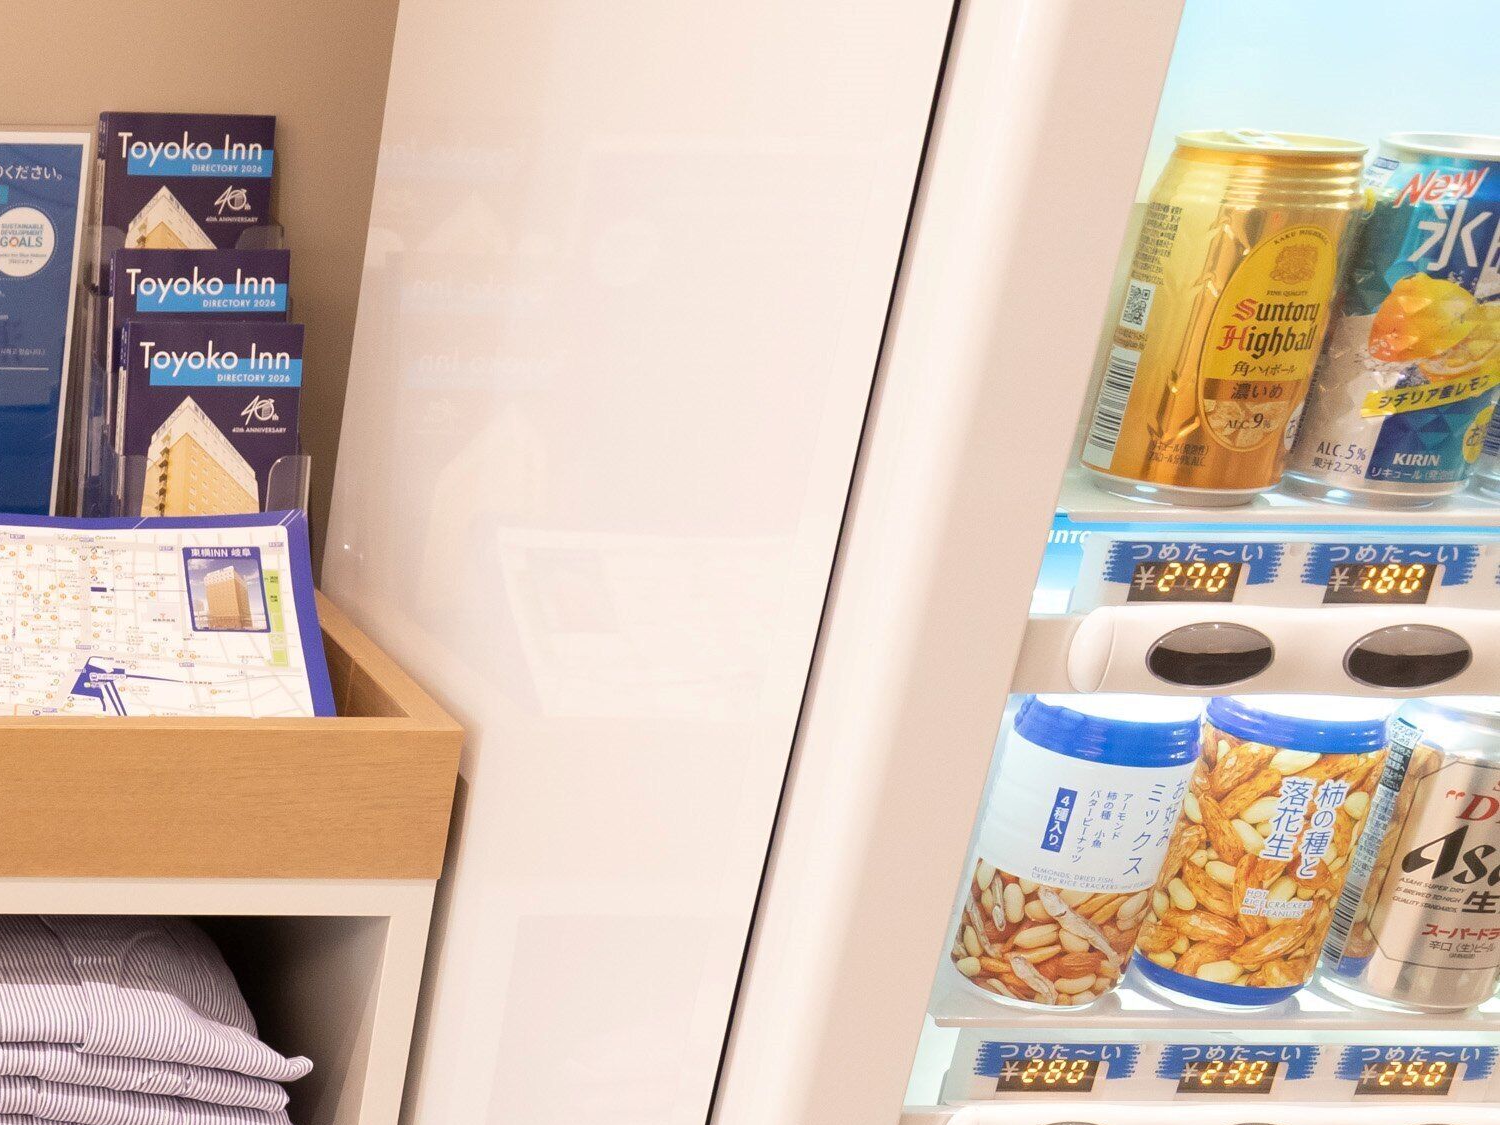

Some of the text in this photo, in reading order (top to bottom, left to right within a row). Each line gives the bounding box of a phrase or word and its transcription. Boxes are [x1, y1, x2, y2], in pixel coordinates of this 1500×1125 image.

[118, 131, 262, 167] Toyoko Inn
[192, 165, 263, 174] DIRECTORY 2026
[1392, 166, 1490, 209] New
[0, 236, 43, 247] GOALS
[1273, 231, 1297, 246] KAKU
[126, 266, 275, 304] Toyoko Inn
[202, 299, 276, 308] DIRECTORY 2026
[1233, 298, 1321, 323] Suntory
[1216, 324, 1318, 360] Highball
[139, 340, 290, 378] Toyoko Inn
[1231, 361, 1297, 378] 角ハイボール
[217, 374, 291, 383] DIRECTORY 2026
[1231, 383, 1284, 400] 濃いめ
[1392, 452, 1441, 467] KIRIN
[190, 548, 228, 558] 東横INN
[1048, 794, 1071, 846] 4種入り
[1090, 790, 1118, 849] 柿の種 小魚
[1112, 792, 1134, 840] アーモンド
[1155, 779, 1187, 848] お好み
[1263, 780, 1314, 859] 落花生
[1071, 789, 1101, 864] バターピーナッツ
[1122, 784, 1167, 876] ミックス
[1299, 783, 1348, 877] 柿の種と
[1247, 889, 1268, 898] HOT
[1399, 877, 1422, 887] ASAHI
[1424, 882, 1449, 892] SUPER
[1244, 898, 1265, 906] RICE
[1392, 895, 1420, 906] QUALITY
[1403, 888, 1431, 899] BREWED
[1443, 896, 1462, 904] HIGH
